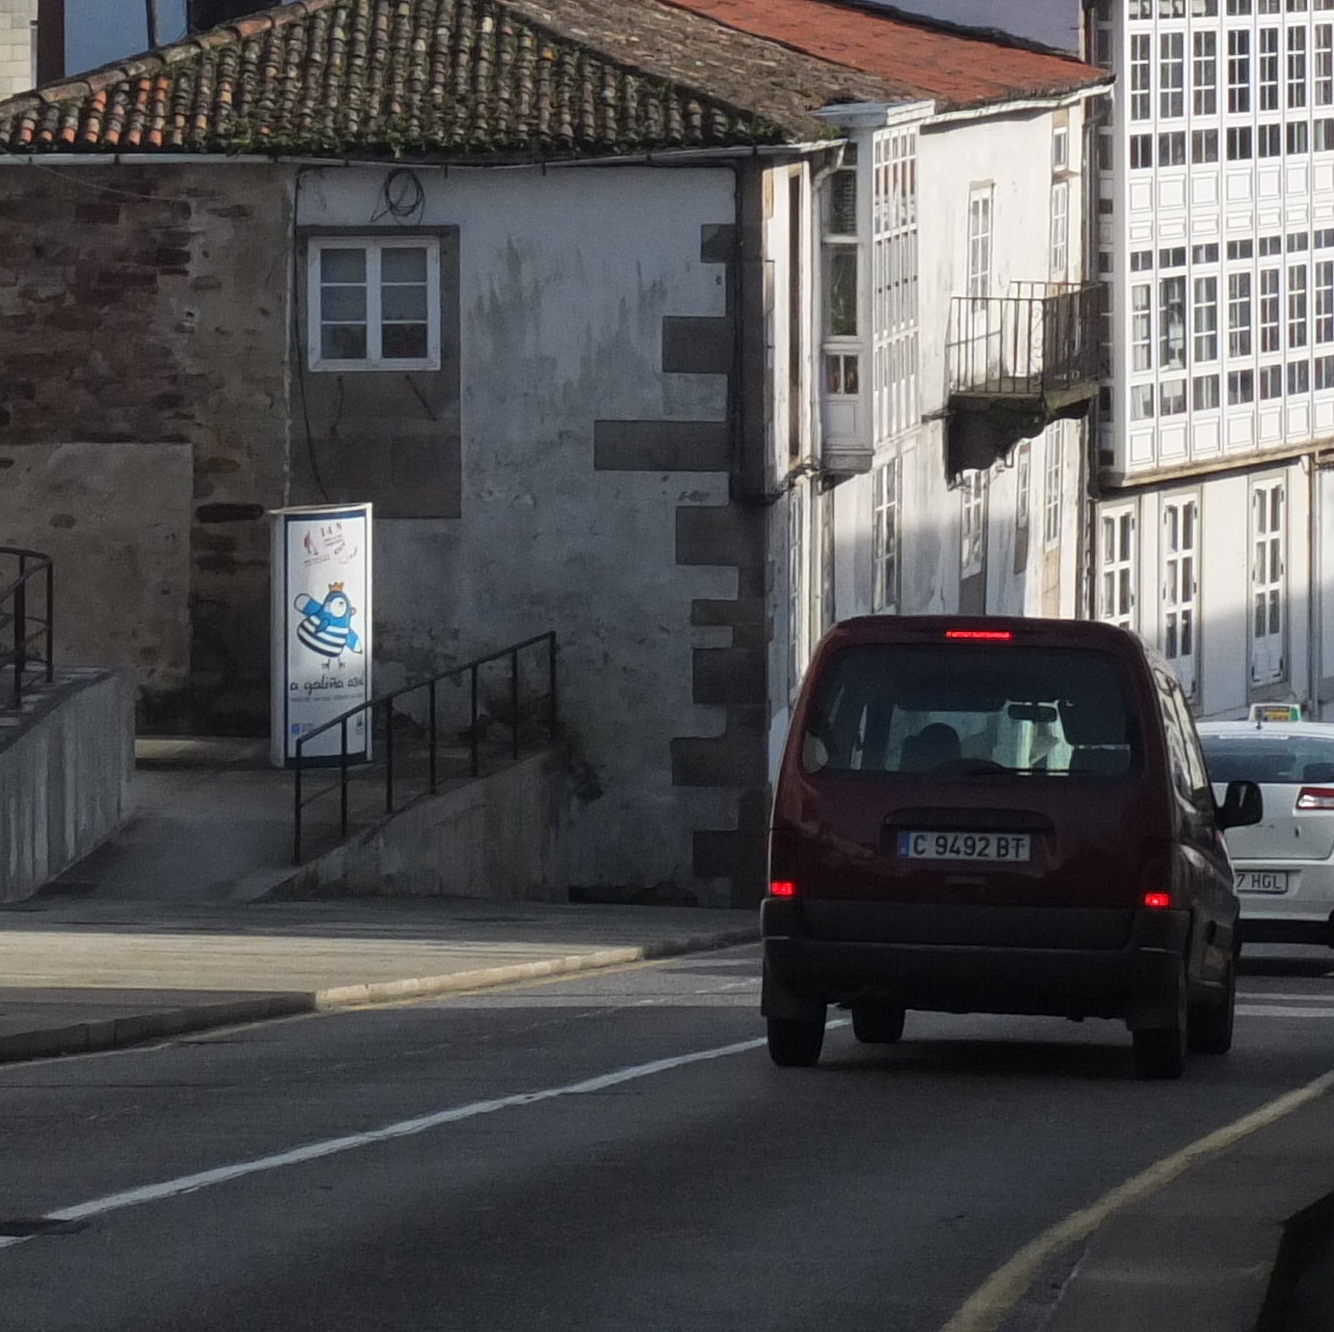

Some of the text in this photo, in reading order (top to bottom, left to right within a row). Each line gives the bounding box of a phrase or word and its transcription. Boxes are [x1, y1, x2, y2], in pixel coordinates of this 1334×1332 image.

[290, 681, 299, 691] a
[913, 834, 1024, 858] C 9492 BT
[1251, 873, 1282, 889] HGL
